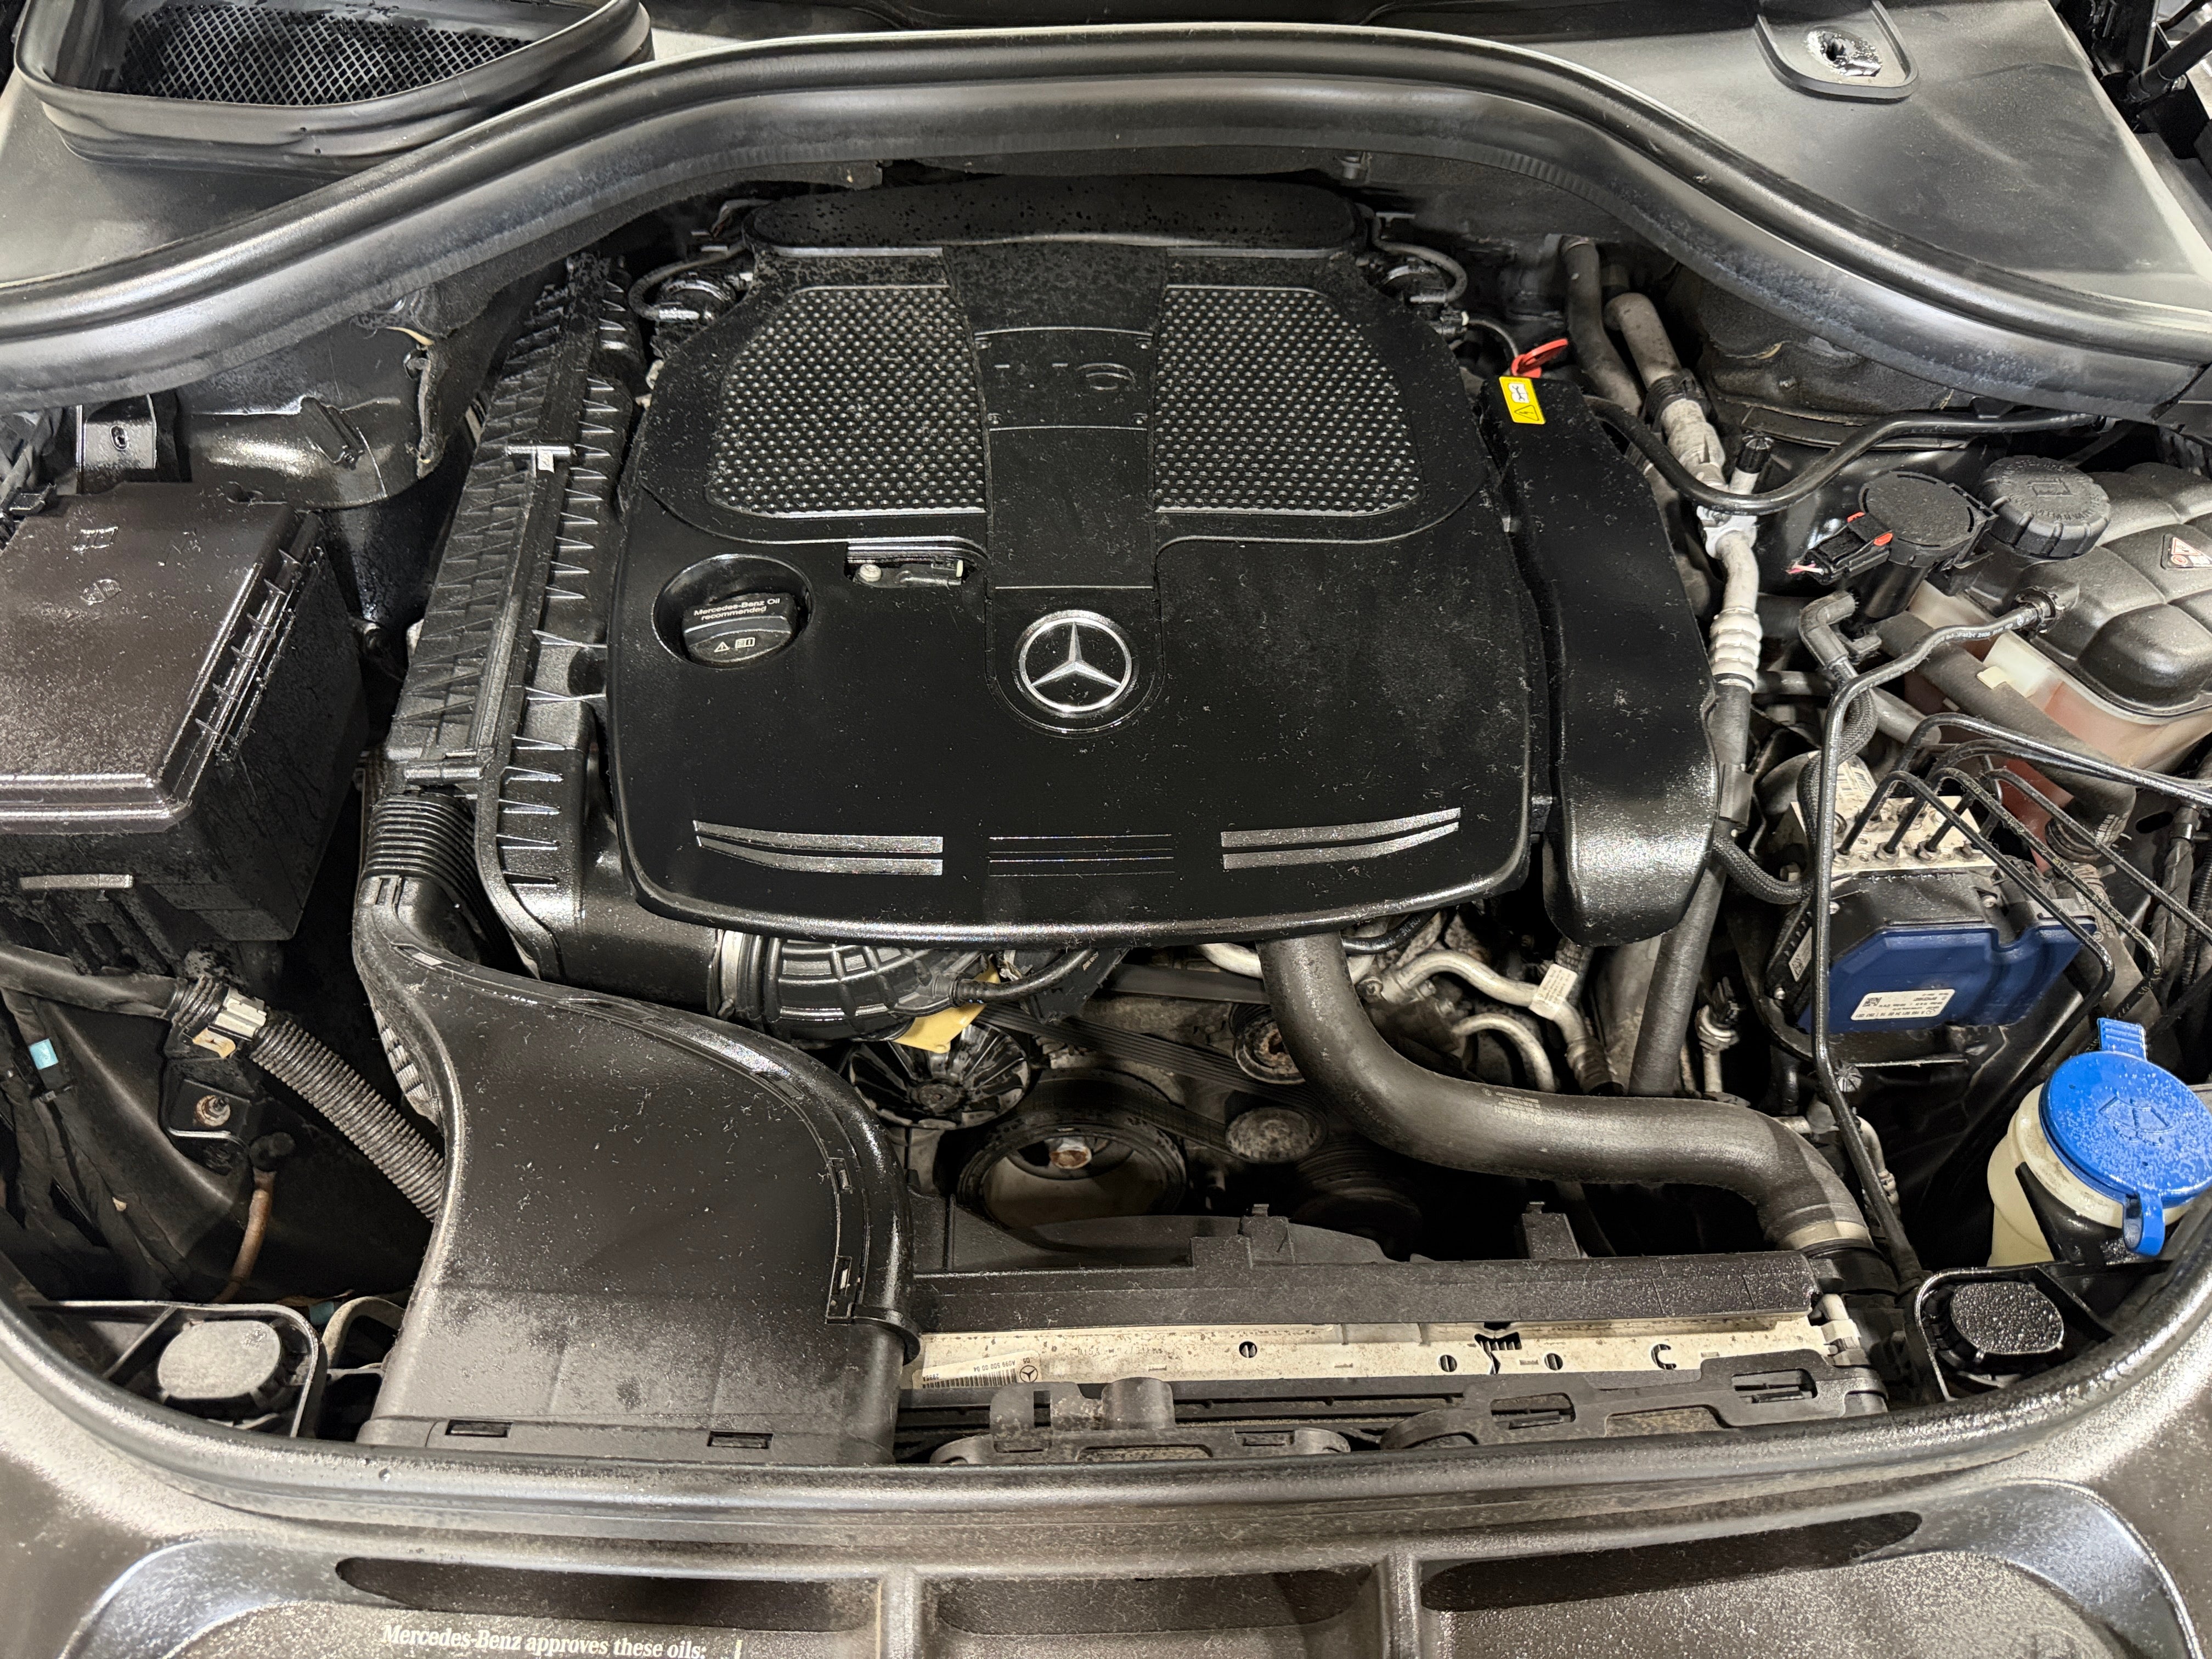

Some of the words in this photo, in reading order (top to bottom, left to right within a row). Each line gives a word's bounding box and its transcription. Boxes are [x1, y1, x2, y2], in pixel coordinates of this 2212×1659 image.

[693, 600, 765, 616] Mercedes-Benz
[701, 605, 767, 621] recommended
[382, 1624, 522, 1650] Mercedes-Benz
[525, 1636, 609, 1657] approves
[613, 1637, 664, 1656] these
[667, 1640, 707, 1659] oils:
